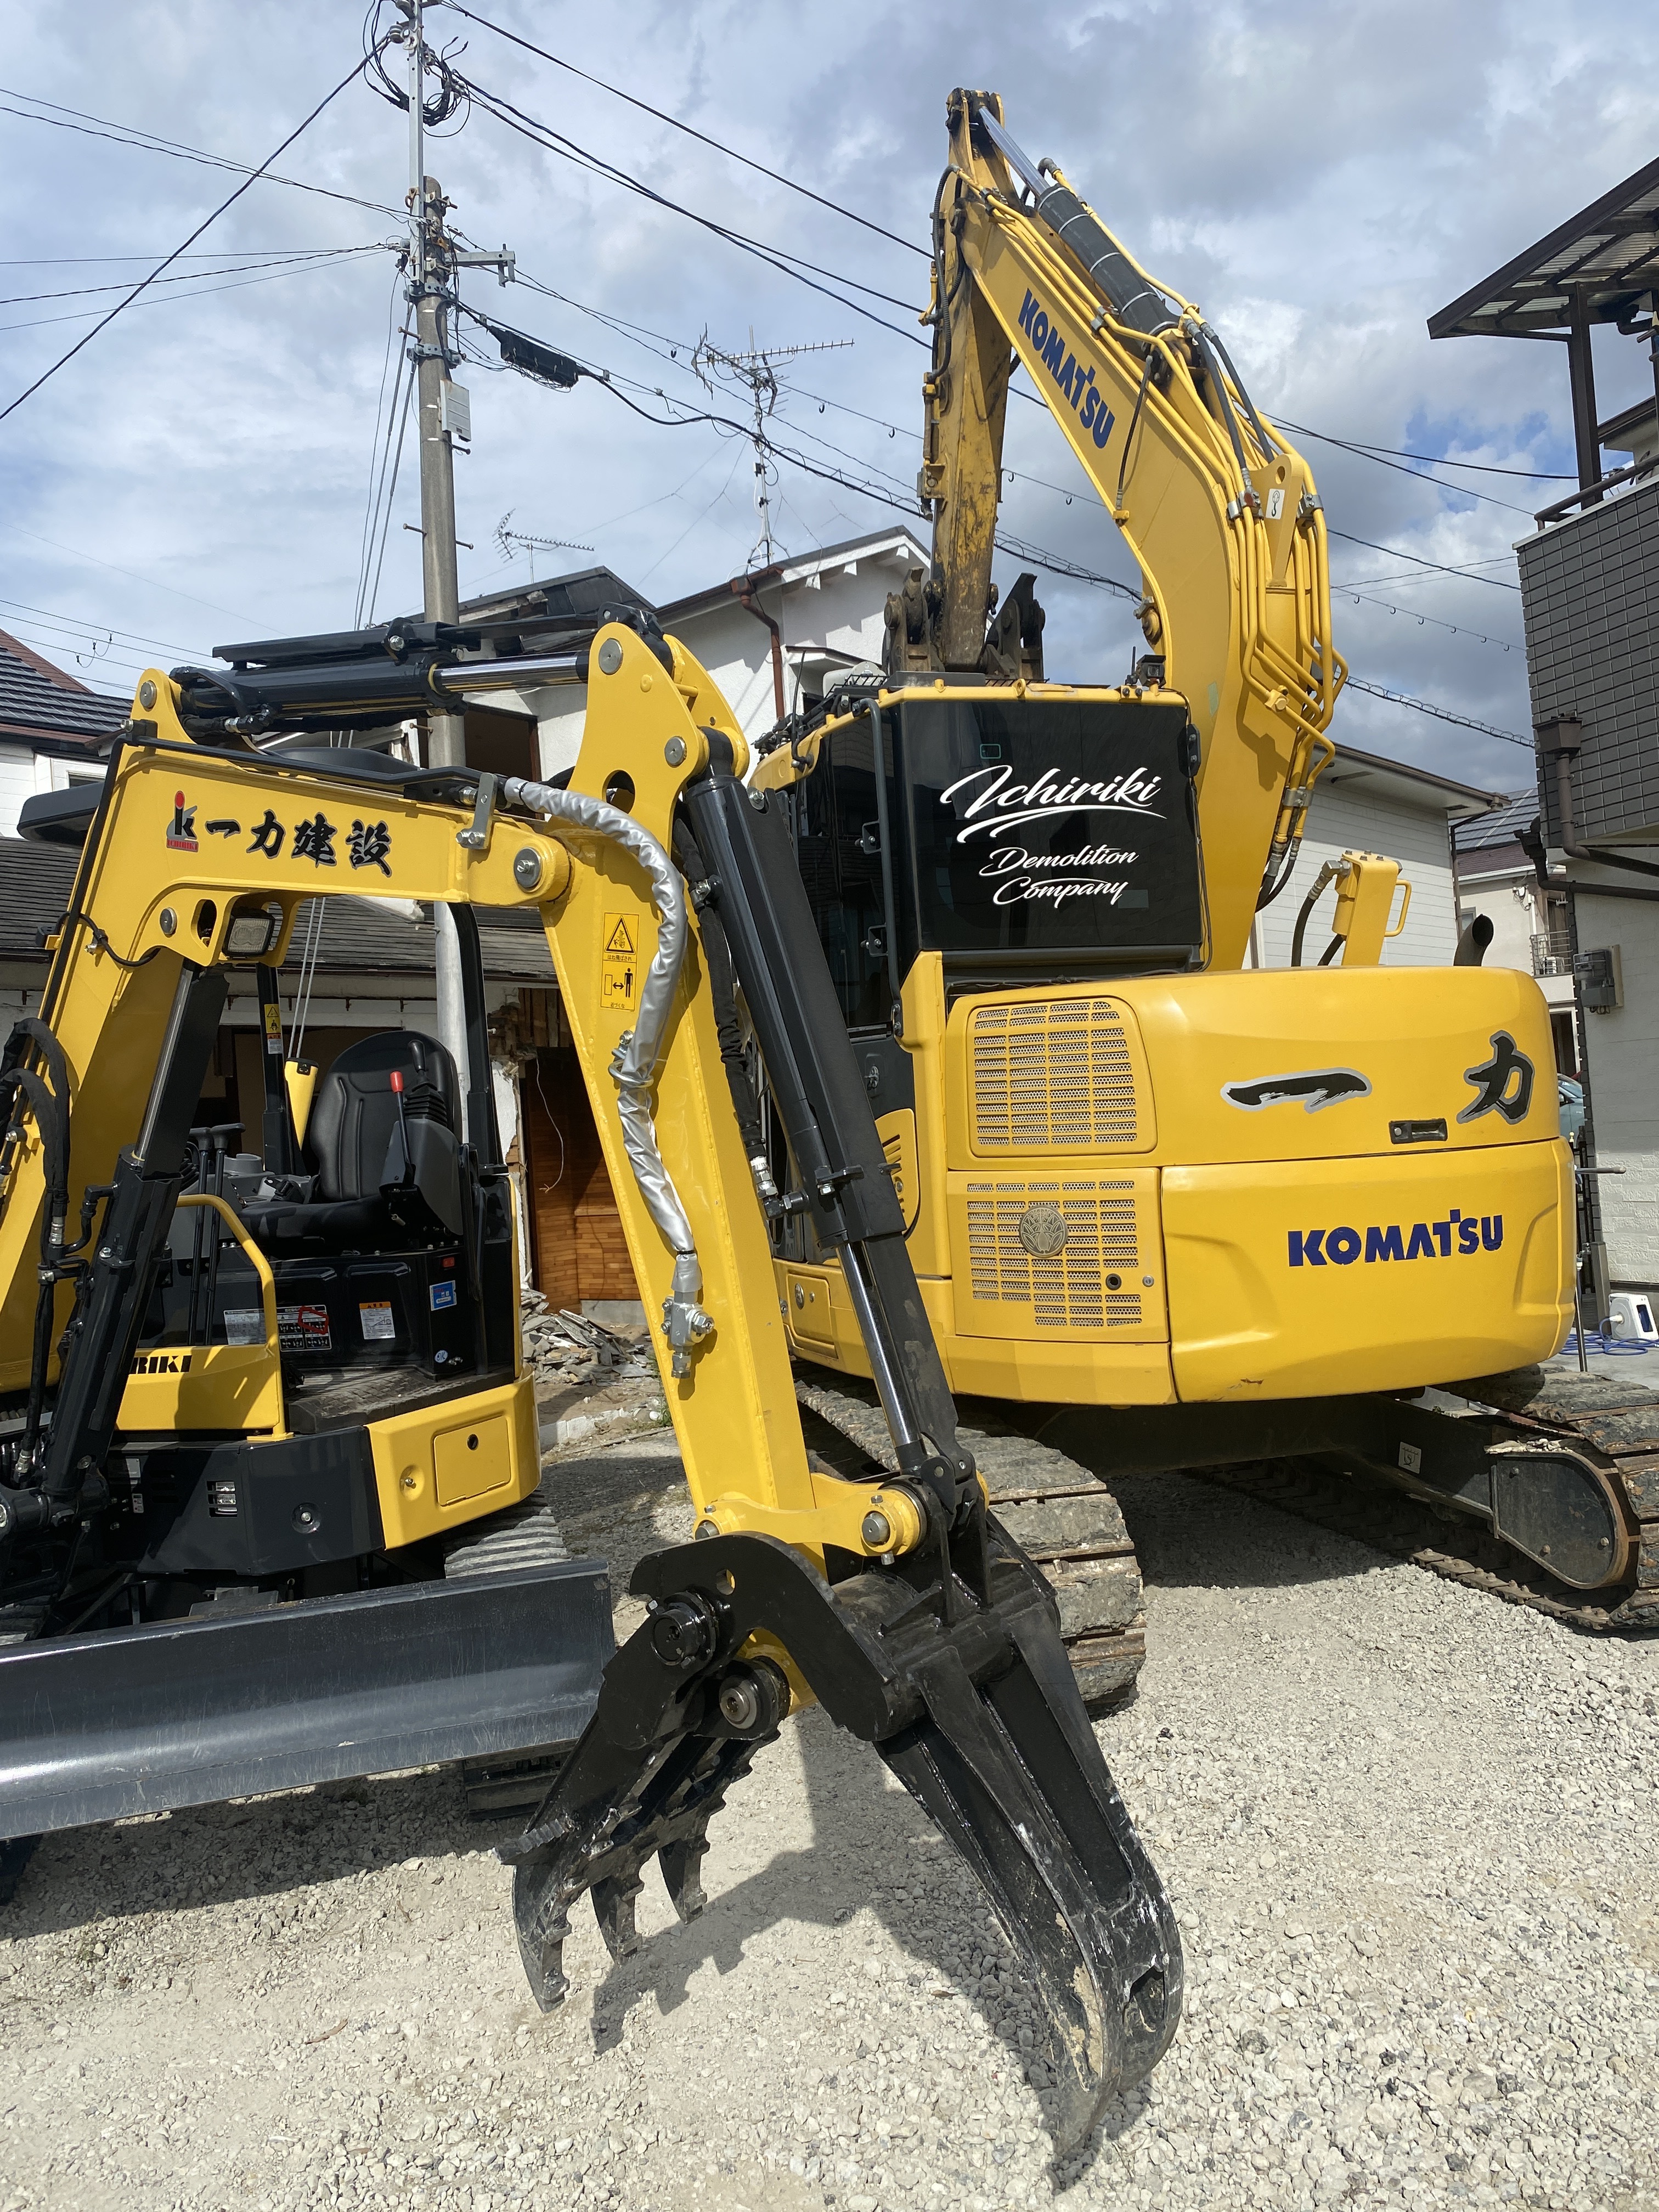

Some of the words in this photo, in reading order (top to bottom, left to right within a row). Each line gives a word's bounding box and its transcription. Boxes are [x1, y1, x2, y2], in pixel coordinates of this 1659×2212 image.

[1017, 288, 1116, 449] KOMATSU
[940, 765, 1163, 821] Ichiriki
[205, 809, 393, 878] 一力建設
[979, 844, 1139, 877] Demolition
[992, 877, 1129, 909] Company
[1288, 1209, 1503, 1267] KOMATSU
[129, 1355, 193, 1374] RIKI
